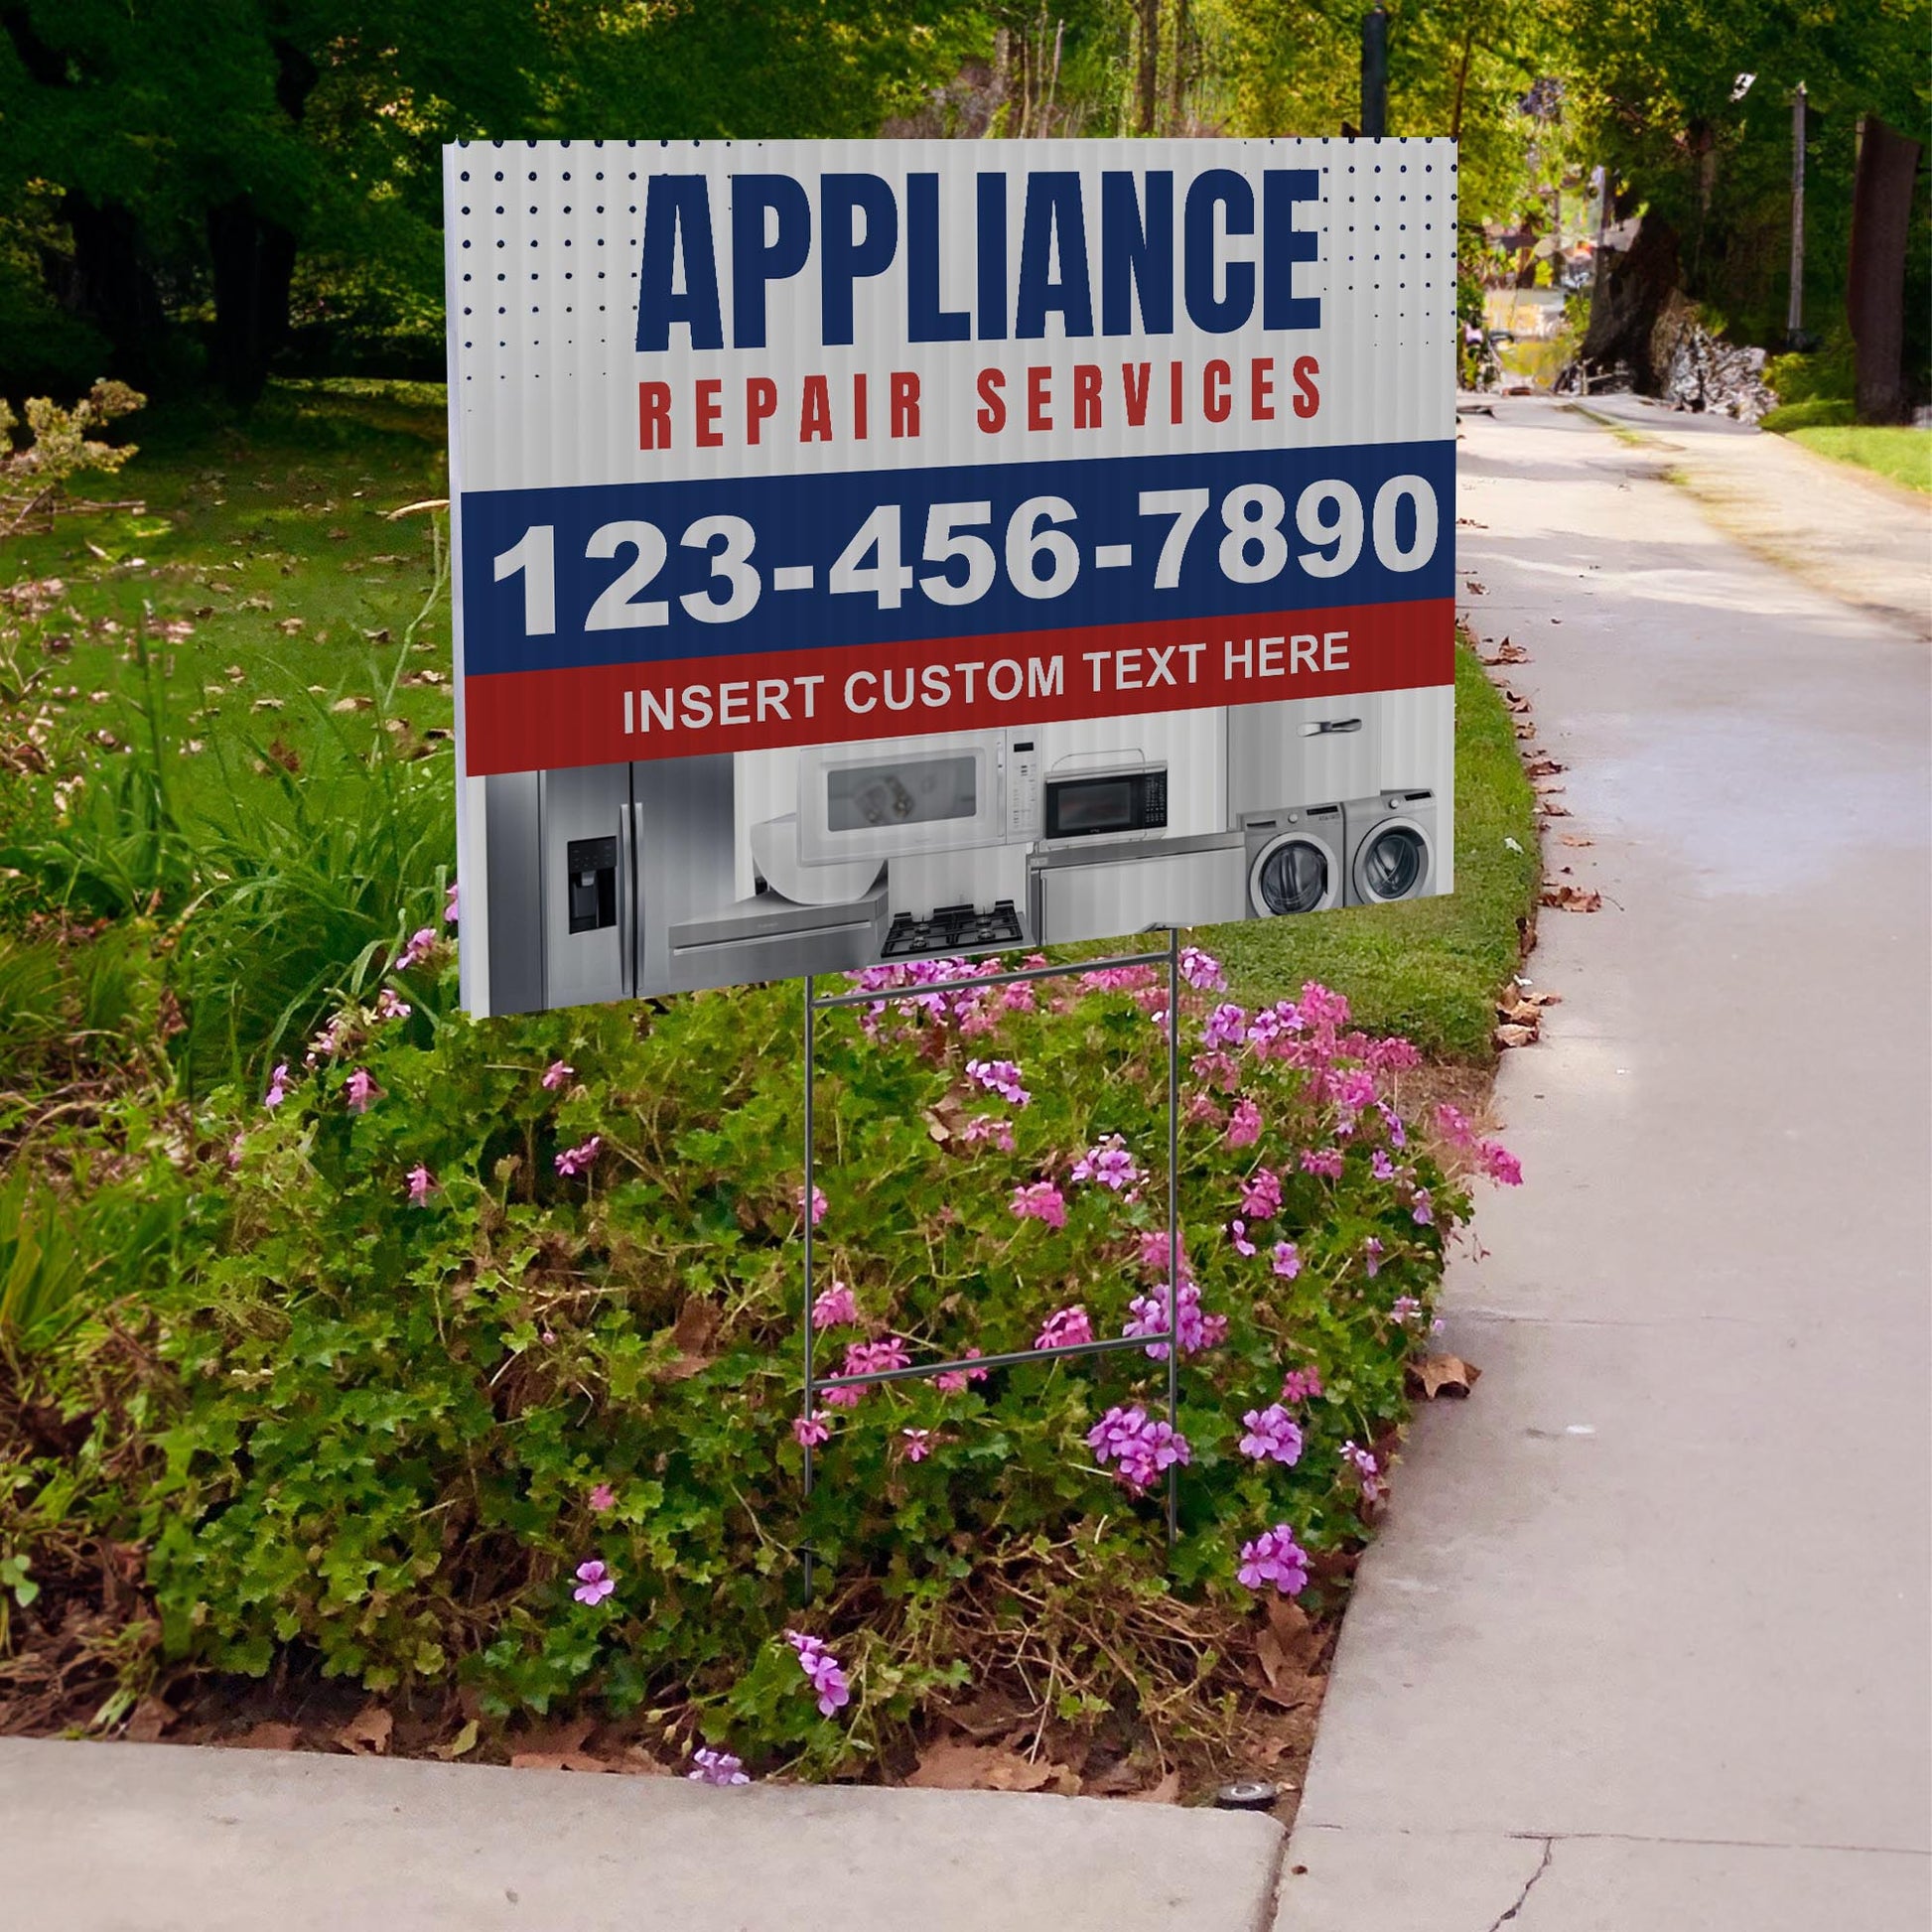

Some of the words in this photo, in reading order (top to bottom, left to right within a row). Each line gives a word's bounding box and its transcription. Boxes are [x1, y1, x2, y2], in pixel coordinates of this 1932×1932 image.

[635, 169, 1320, 352] APPLIANCE
[639, 372, 920, 450] REPAIR
[977, 355, 1319, 433] SERVICES
[494, 476, 1438, 635] 123-456-7890
[624, 675, 824, 734] INSERT
[845, 655, 1063, 713] CUSTOM
[1083, 643, 1206, 691] TEXT
[1225, 631, 1349, 680] HERE
